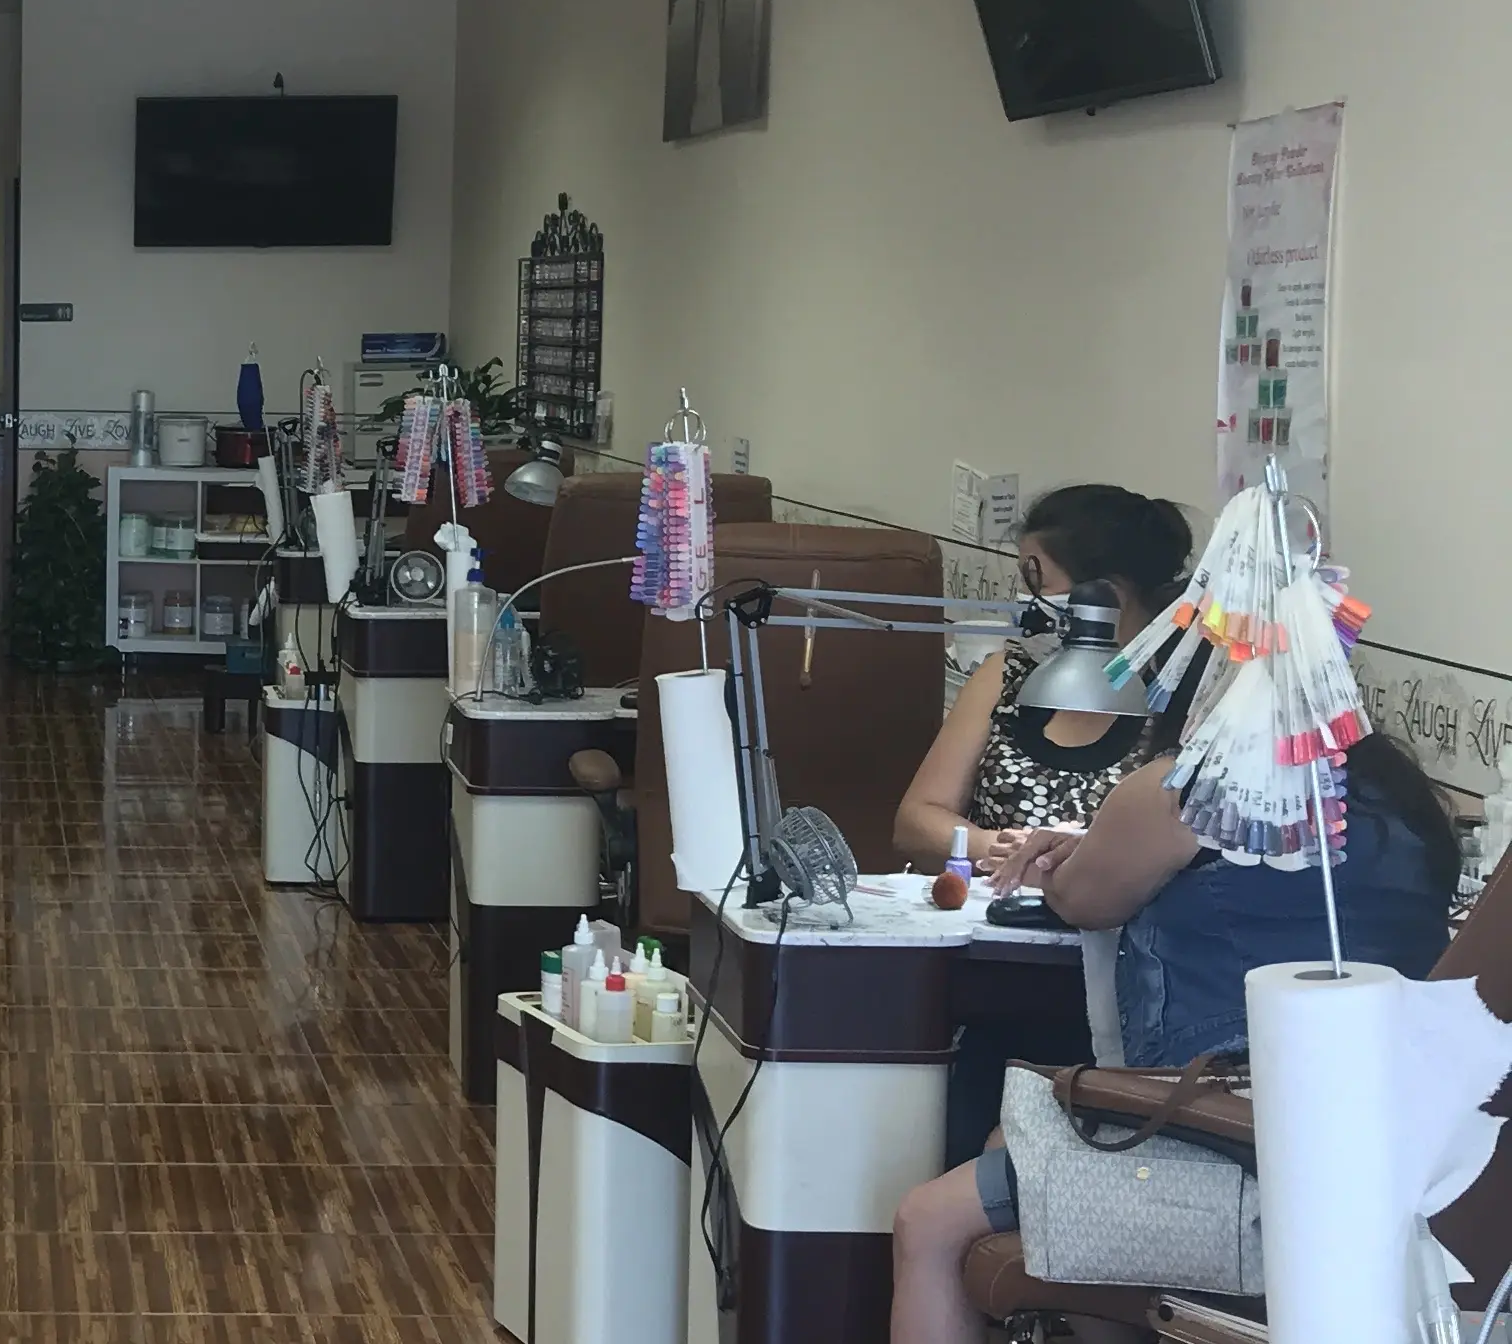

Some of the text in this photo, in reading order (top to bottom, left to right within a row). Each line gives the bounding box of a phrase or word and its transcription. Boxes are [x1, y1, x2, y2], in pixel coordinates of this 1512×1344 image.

[103, 419, 131, 441] LOV
[1349, 664, 1386, 724] OVE
[1396, 678, 1459, 744] LAUGH
